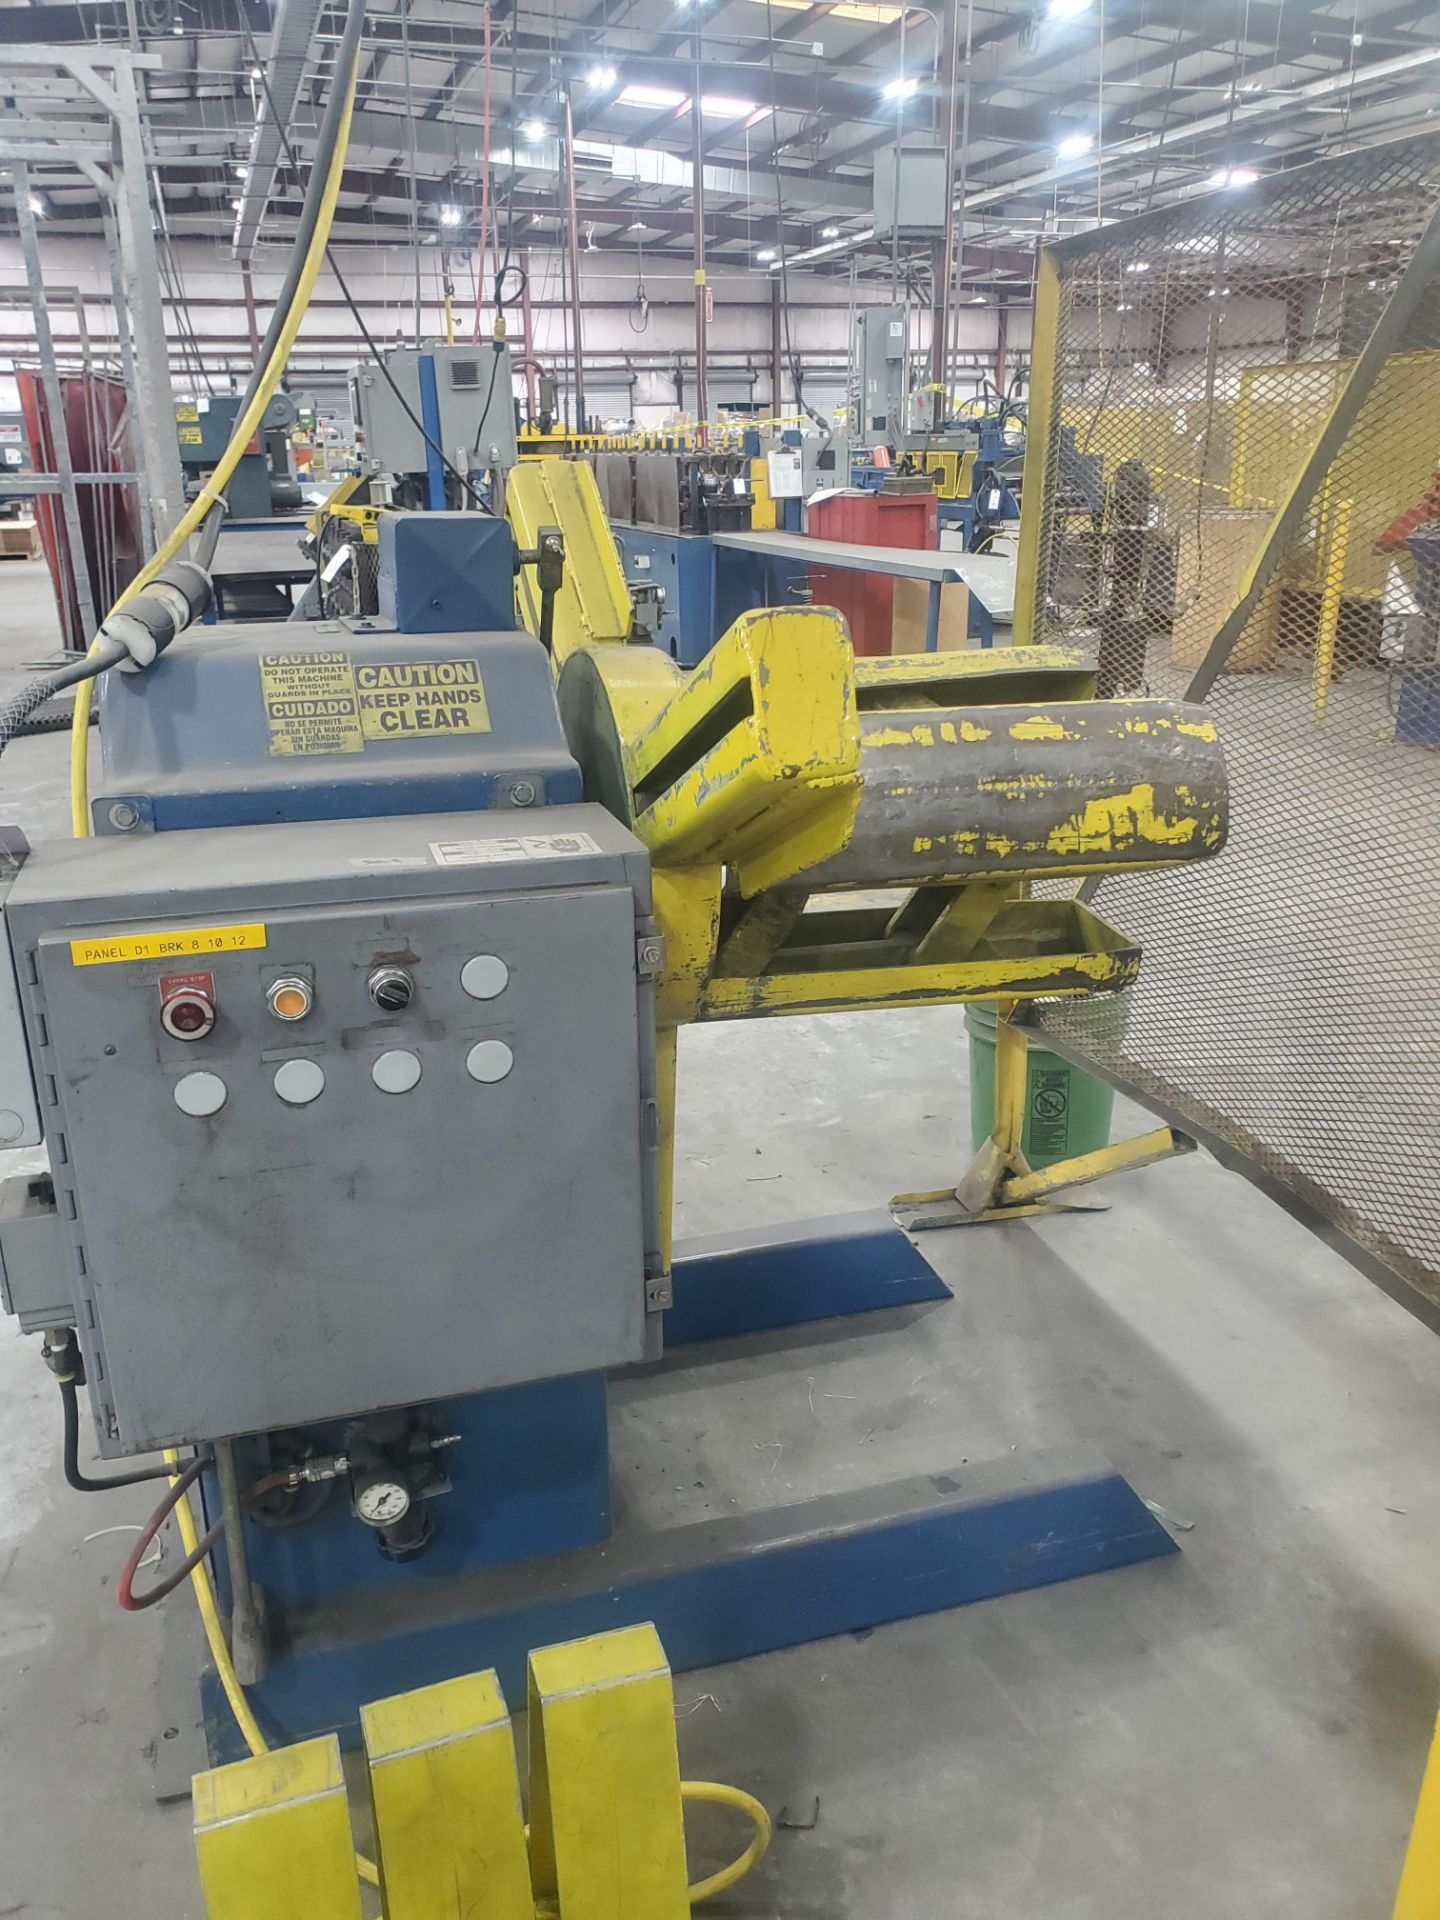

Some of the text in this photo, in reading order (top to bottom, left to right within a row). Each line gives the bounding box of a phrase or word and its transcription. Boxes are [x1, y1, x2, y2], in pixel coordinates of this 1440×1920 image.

[266, 653, 344, 665] CAUTION
[304, 666, 349, 674] OPERATE
[358, 663, 475, 688] CAUTION
[298, 674, 343, 682] MACHINE
[268, 690, 306, 698] GUARDS
[360, 689, 481, 709] KEEP HANDS
[272, 701, 351, 717] CUIDADO
[285, 718, 342, 728] NO SE PERMITE
[380, 707, 470, 732] CLEAR
[85, 936, 246, 960] PANEL D1 BRK 8 10 12
